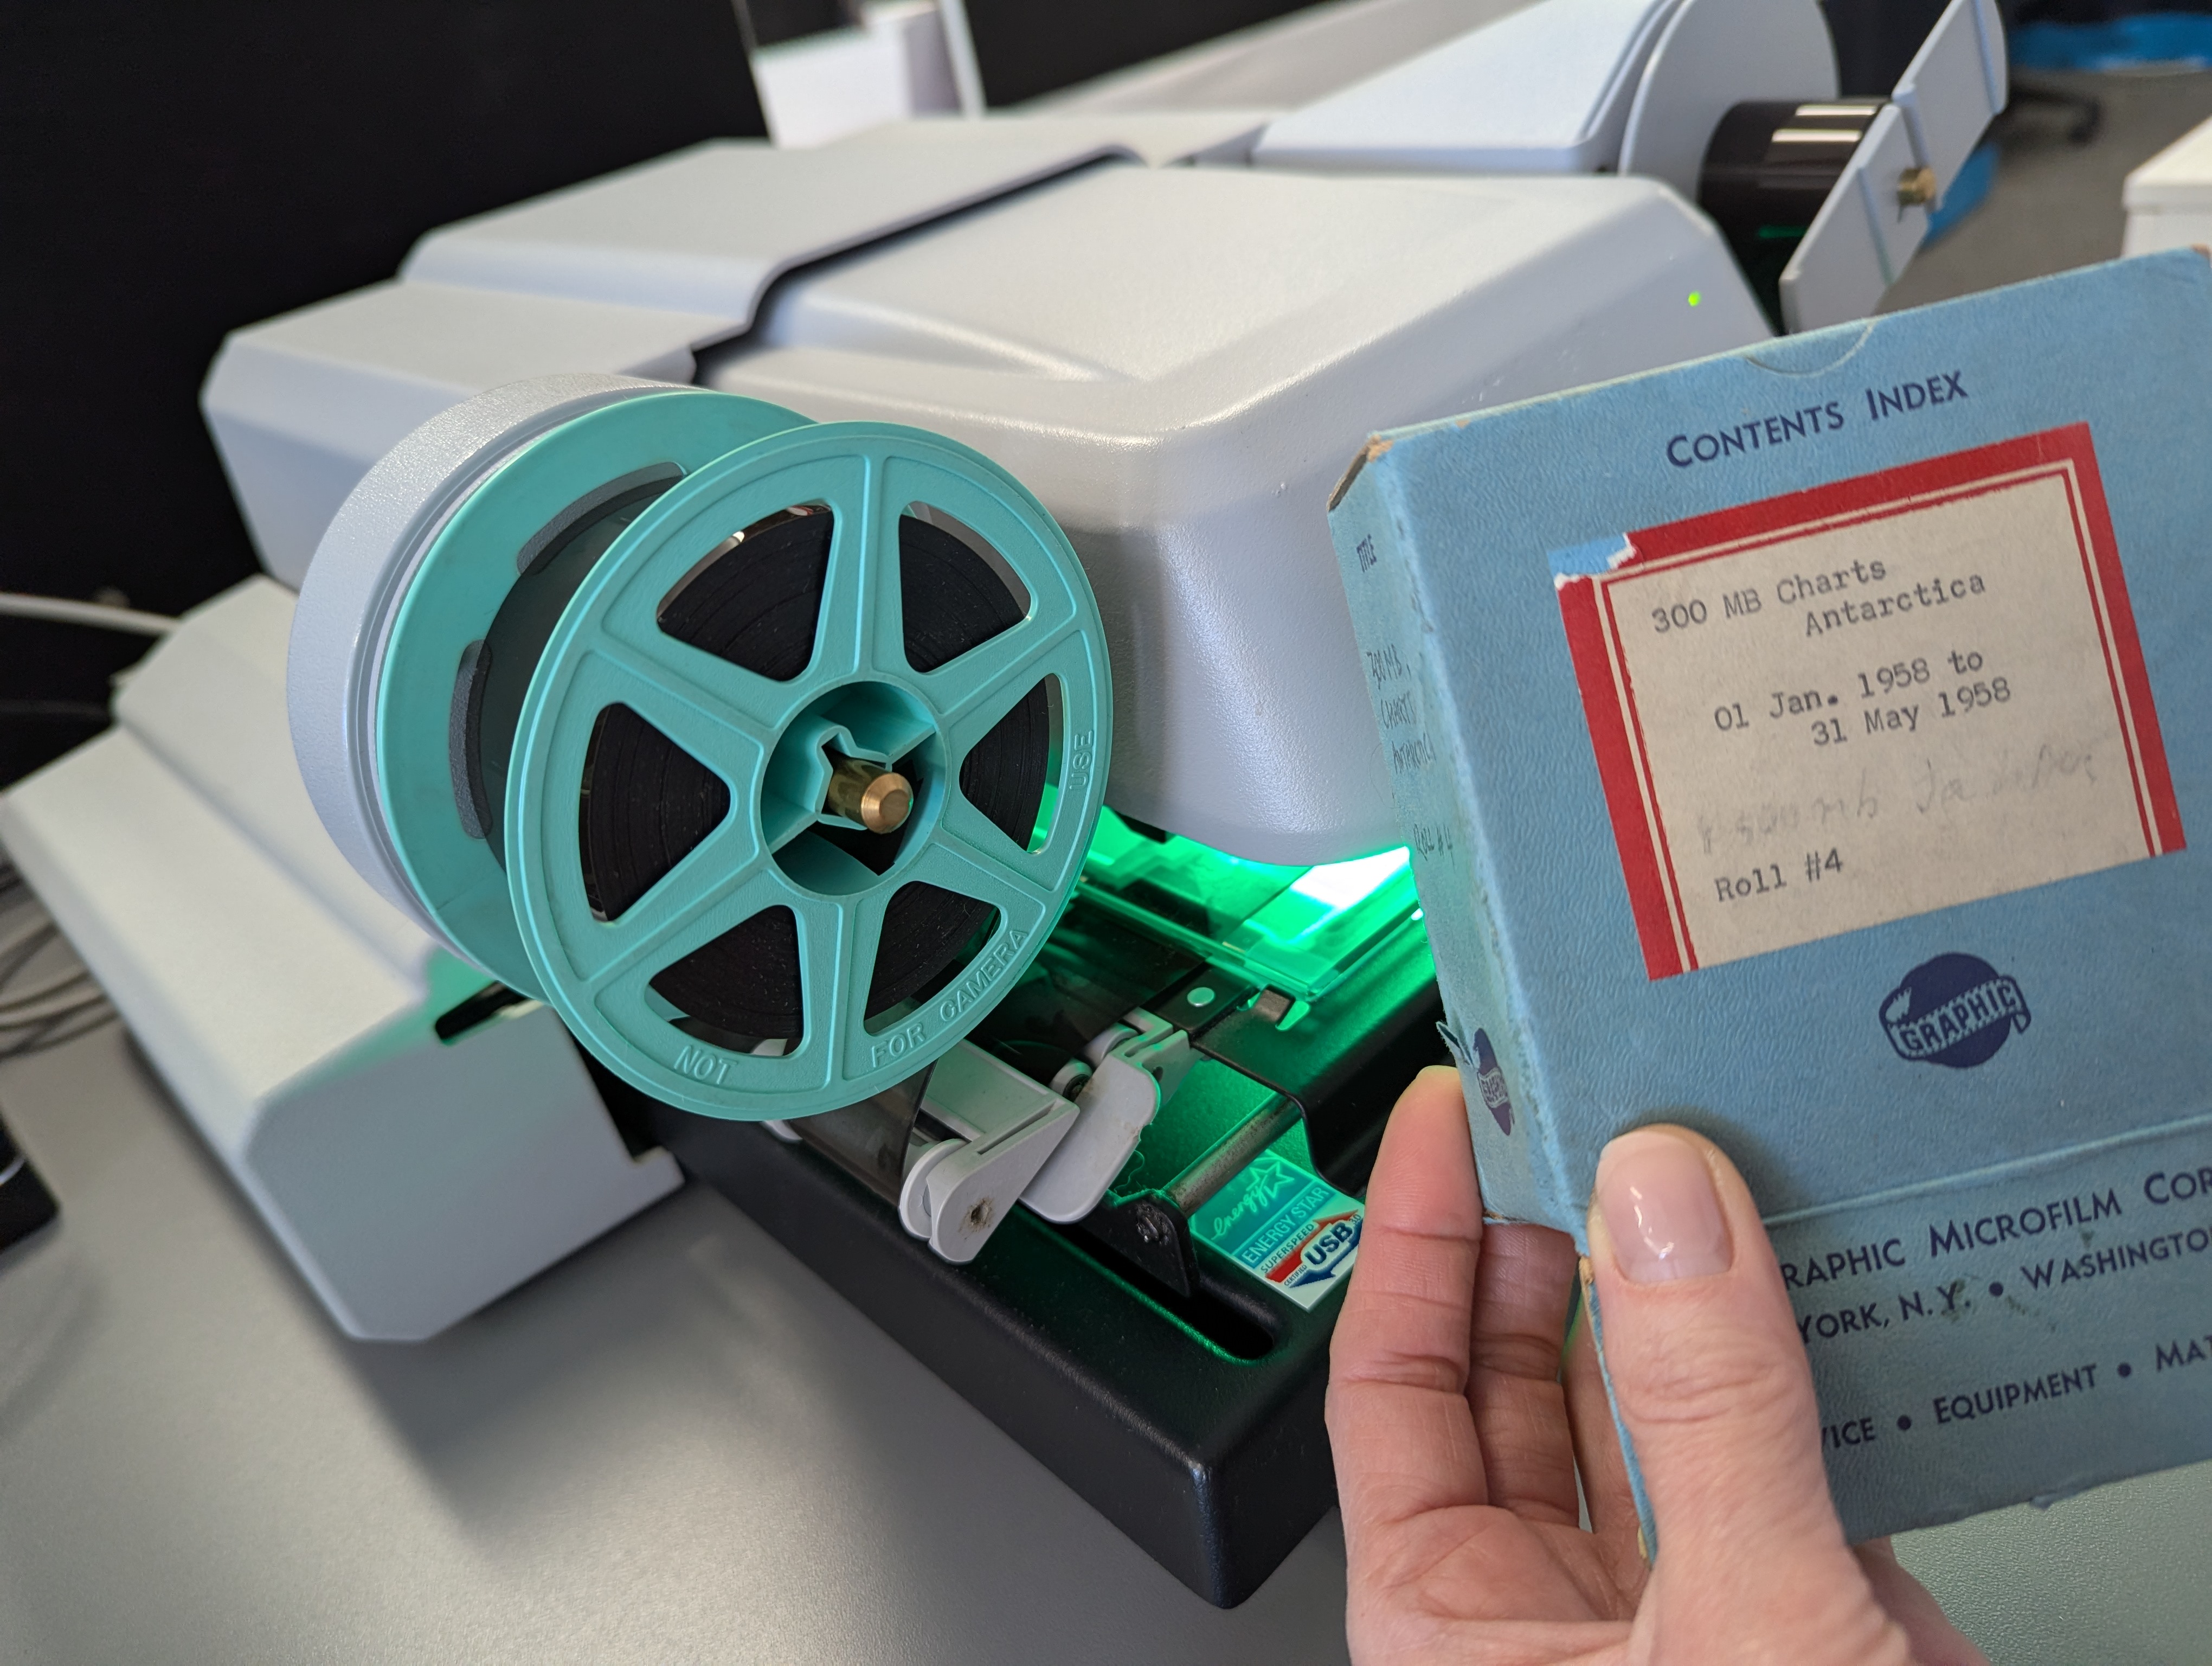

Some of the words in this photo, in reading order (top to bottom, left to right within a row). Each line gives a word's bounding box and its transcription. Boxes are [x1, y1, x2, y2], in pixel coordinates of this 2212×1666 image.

[1666, 402, 1844, 467] CONTENTS
[1865, 371, 1969, 421] INDEX
[1652, 599, 1708, 633] 300
[1724, 588, 1762, 621] MB
[1777, 557, 1887, 605] Charts
[1805, 571, 1986, 637] Antarctica
[1714, 703, 1750, 732] 01
[1769, 686, 1838, 720] Jan.
[1858, 657, 1931, 700] 1958
[1948, 650, 1984, 675] to
[1811, 717, 1847, 747] 31
[1863, 700, 1920, 735] May
[1939, 676, 2012, 719] 1958
[673, 1043, 739, 1085] NOT
[870, 1025, 927, 1068] FOR
[939, 928, 1028, 1023] CAMERA
[1069, 728, 1094, 791] USE
[1715, 863, 1788, 902] Roll
[1805, 847, 1844, 883] #4
[1900, 985, 2017, 1050] GRAPHIC
[1211, 1174, 1268, 1241] energy
[1242, 1214, 1296, 1263] ENERGY
[1291, 1187, 1329, 1218] STAR
[1304, 1221, 1353, 1265] USB
[1349, 1214, 1361, 1224] 3.0
[1780, 1238, 1905, 1291] RAPHIC
[1929, 1188, 2122, 1258] MICROFILM
[1261, 1223, 1315, 1274] SUPERSPEED
[1284, 1264, 1308, 1286] CERTIFIED
[1797, 1302, 1890, 1344] YORK,
[2020, 1227, 2212, 1291] WASHINGTO
[1932, 1362, 2097, 1424] EQUIPMENT
